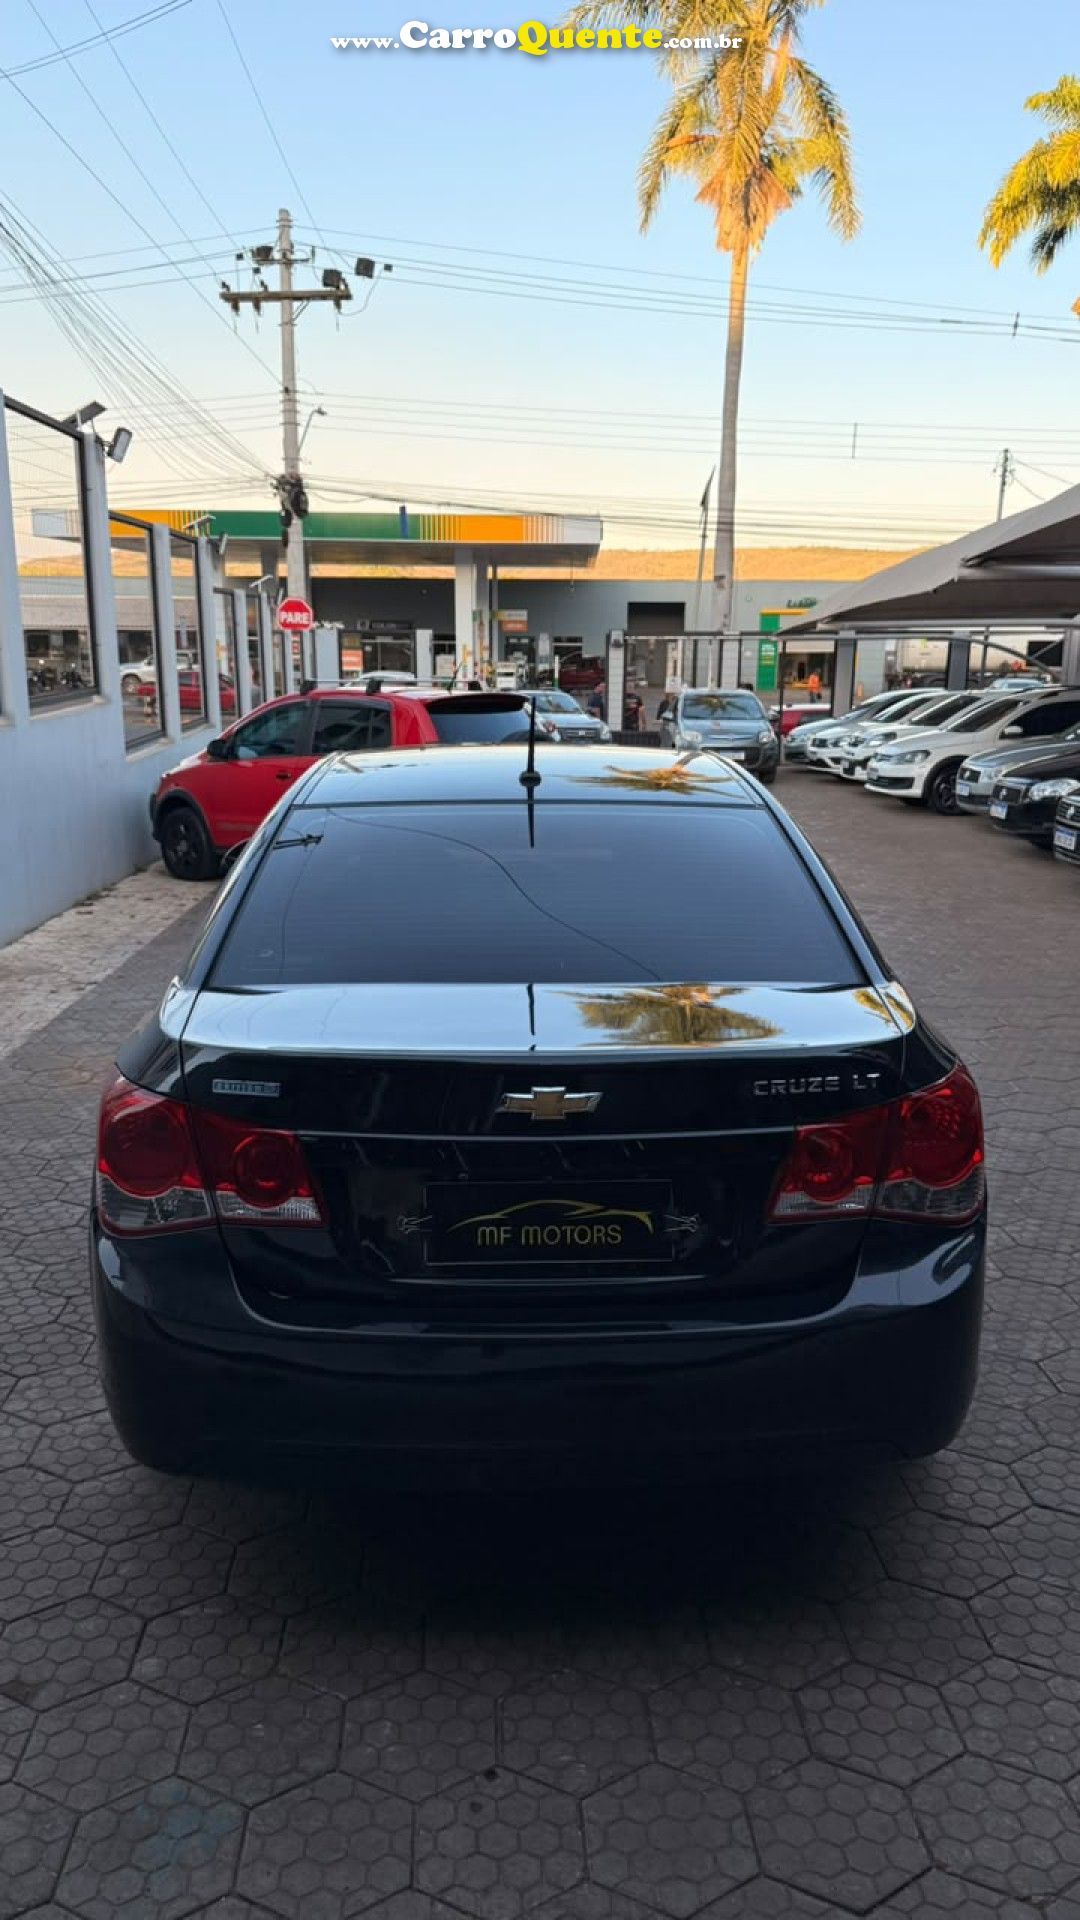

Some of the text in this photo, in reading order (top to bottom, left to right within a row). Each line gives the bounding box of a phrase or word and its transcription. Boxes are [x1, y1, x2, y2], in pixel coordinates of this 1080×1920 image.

[279, 611, 311, 625] PARE
[753, 1073, 880, 1096] CRUZE LT
[477, 1224, 622, 1246] MF MOTORS
